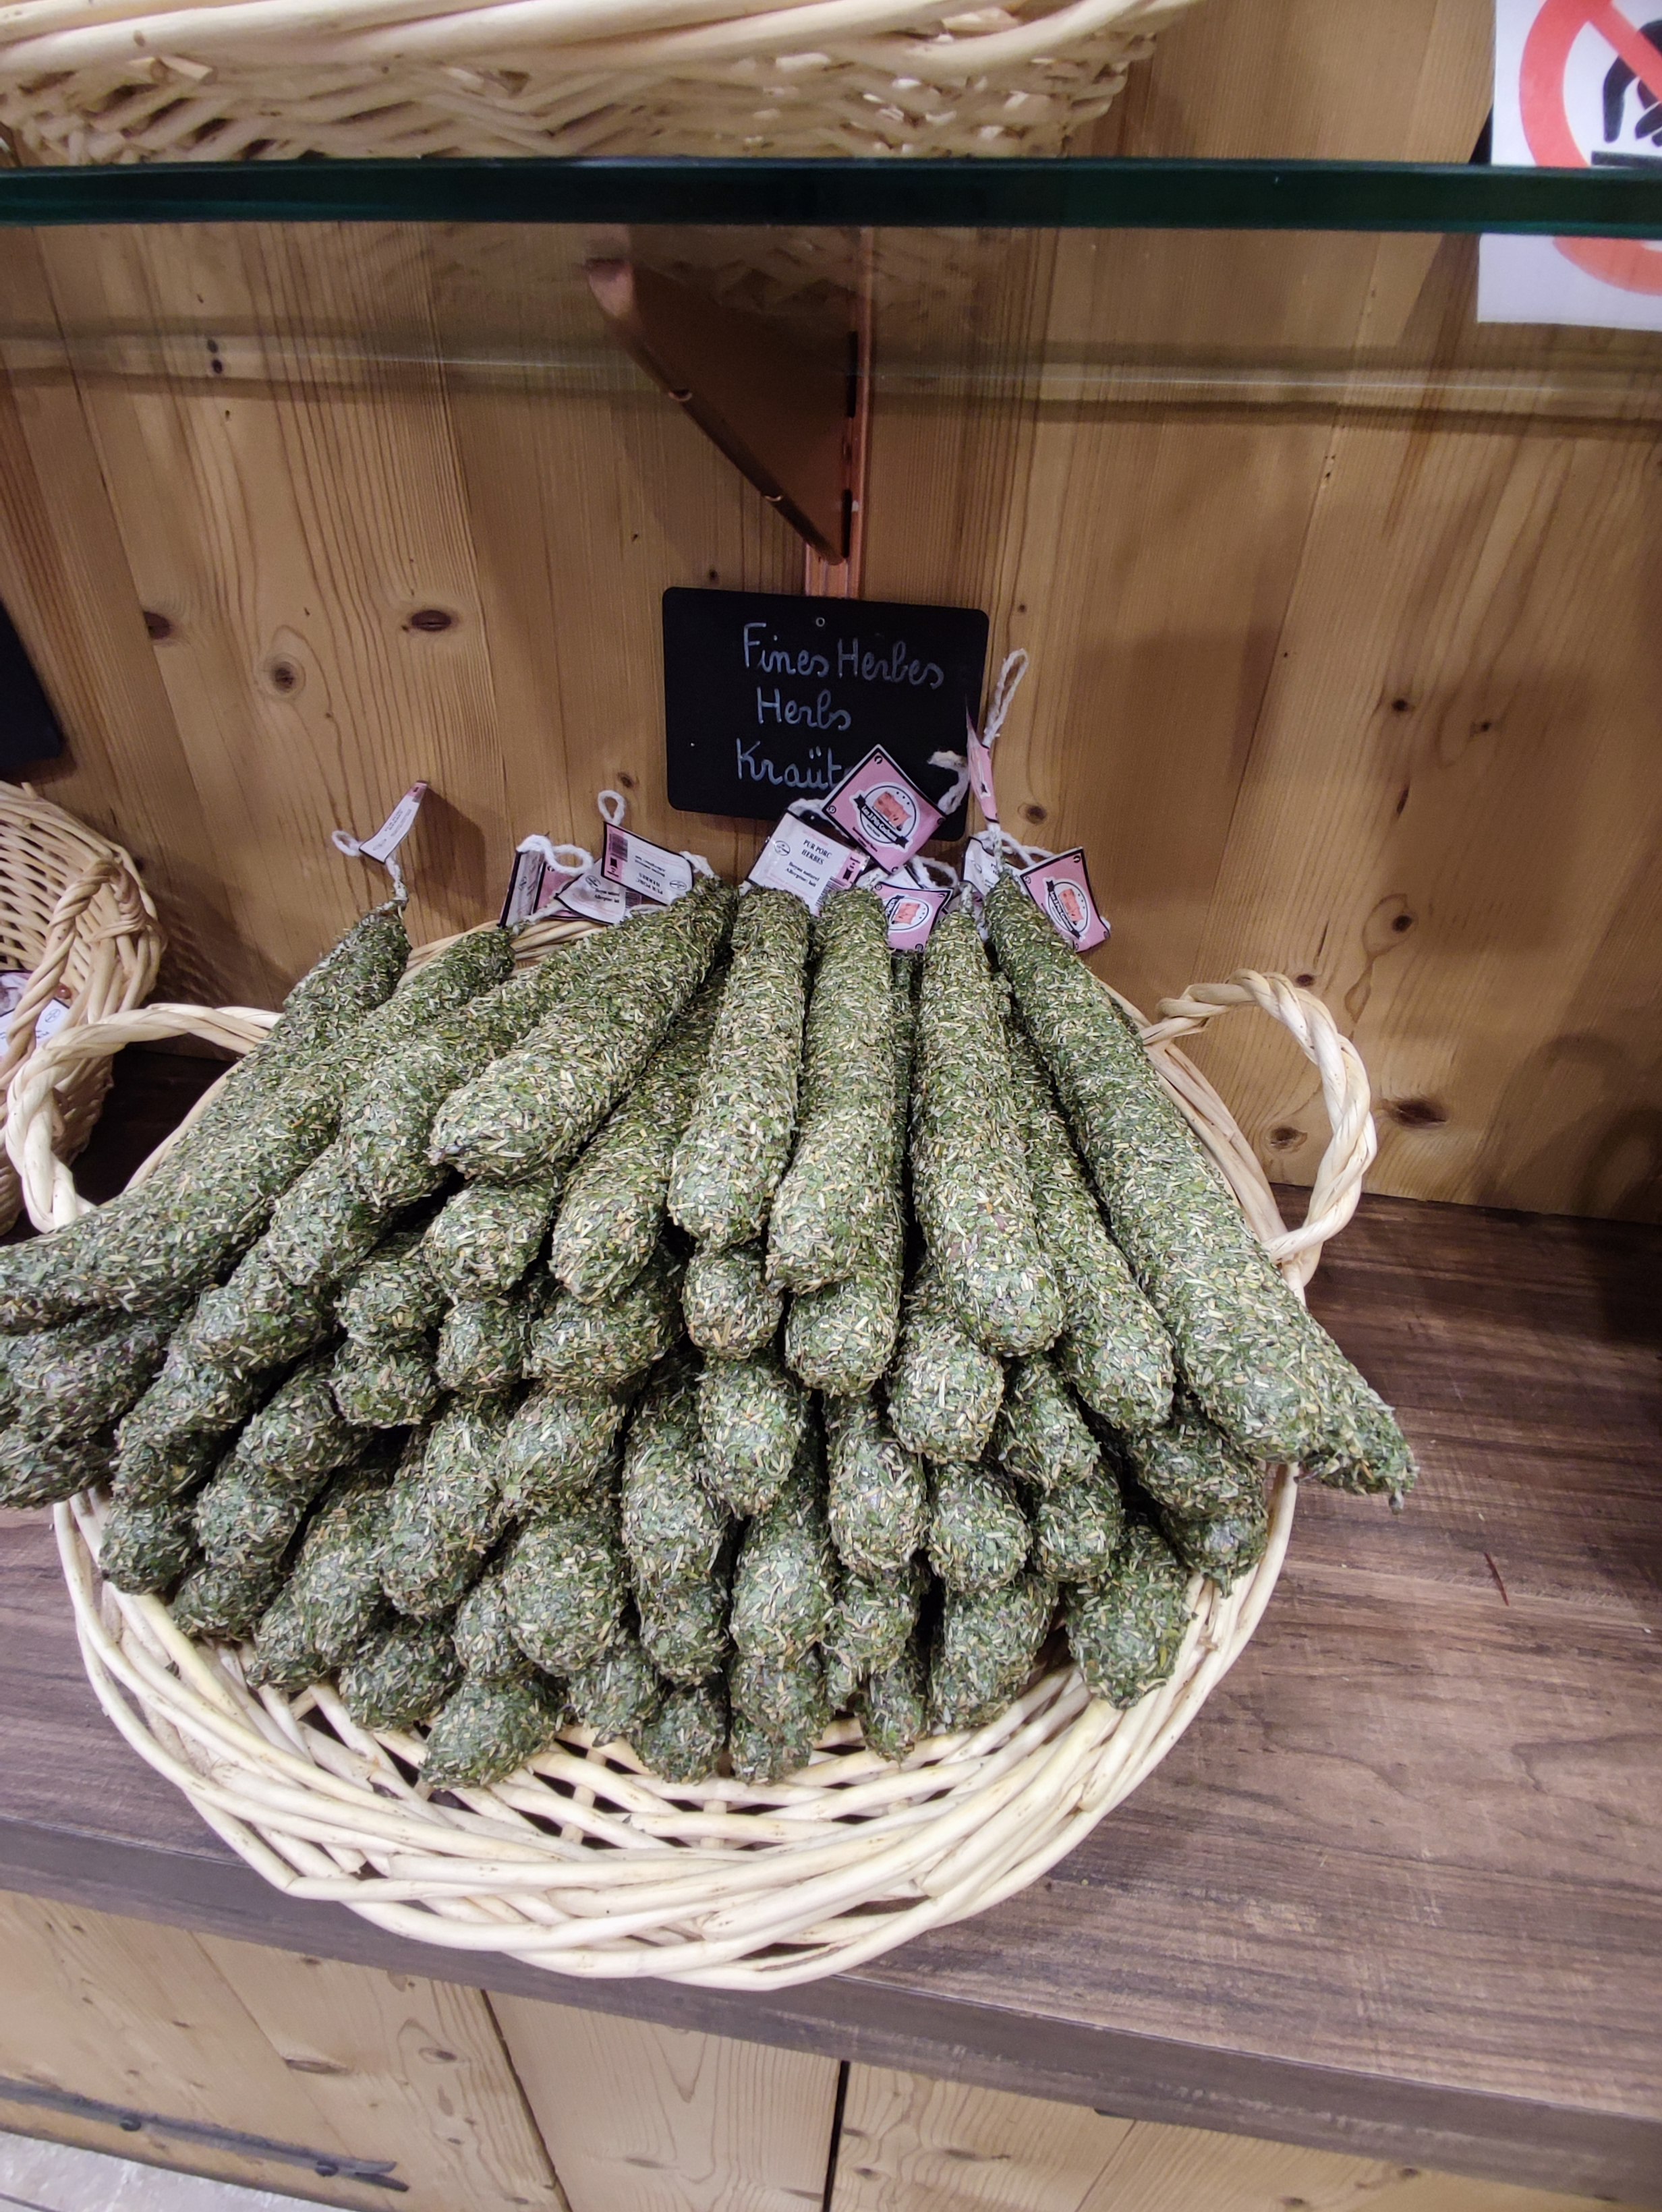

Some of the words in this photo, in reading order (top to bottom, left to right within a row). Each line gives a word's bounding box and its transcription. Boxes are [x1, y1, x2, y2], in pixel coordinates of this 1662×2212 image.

[743, 622, 830, 676] Fines
[837, 637, 945, 690] Herbes
[756, 687, 853, 731] Herbs
[736, 737, 854, 789] Kraüt
[803, 840, 815, 850] PUR
[815, 846, 832, 858] PORC
